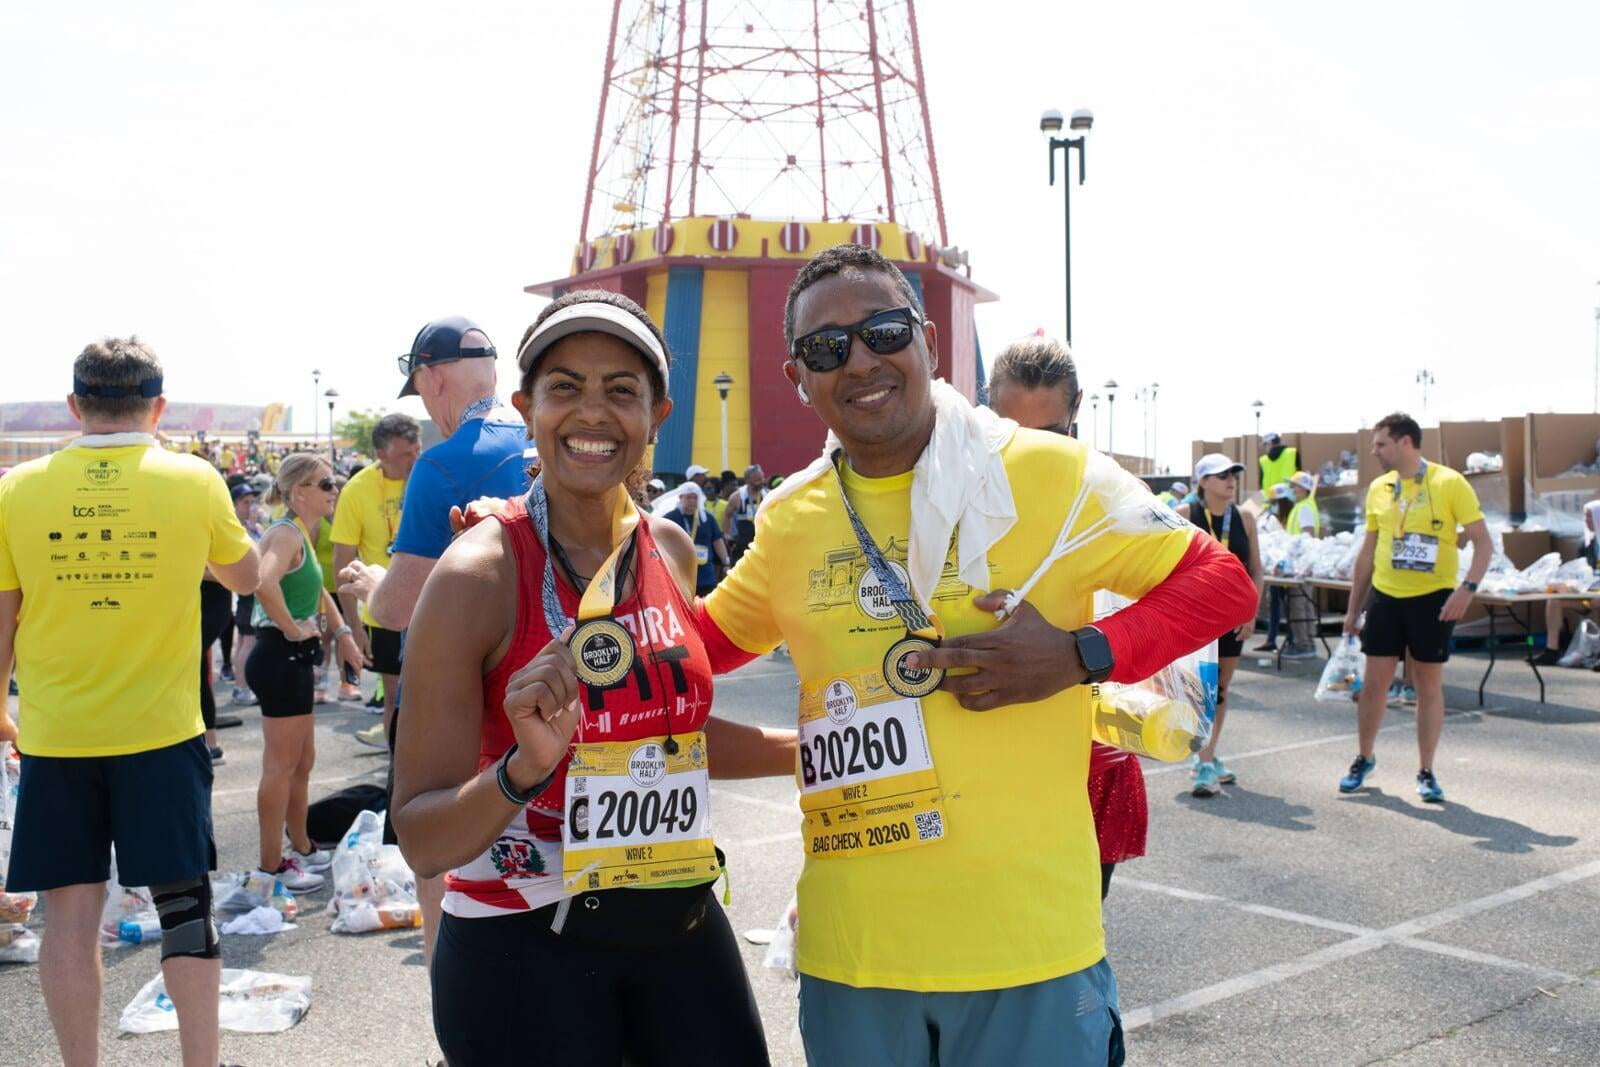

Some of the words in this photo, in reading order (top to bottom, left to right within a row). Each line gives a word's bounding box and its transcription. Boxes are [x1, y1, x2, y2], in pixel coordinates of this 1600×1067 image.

[583, 646, 620, 660] BROOKLYN
[593, 656, 611, 667] HALF
[904, 669, 921, 679] HALF
[826, 695, 854, 710] BROOKLYN
[834, 705, 848, 717] HALF
[631, 760, 666, 769] BROOKLYN
[639, 769, 657, 778] HALF
[841, 786, 862, 801] WAVE
[862, 784, 868, 797] 2
[596, 786, 698, 839] 20049
[812, 836, 830, 853] BAG
[831, 831, 863, 850] CHECK
[866, 821, 911, 847] 20260
[625, 847, 647, 861] WAVE
[647, 846, 653, 859] 2
